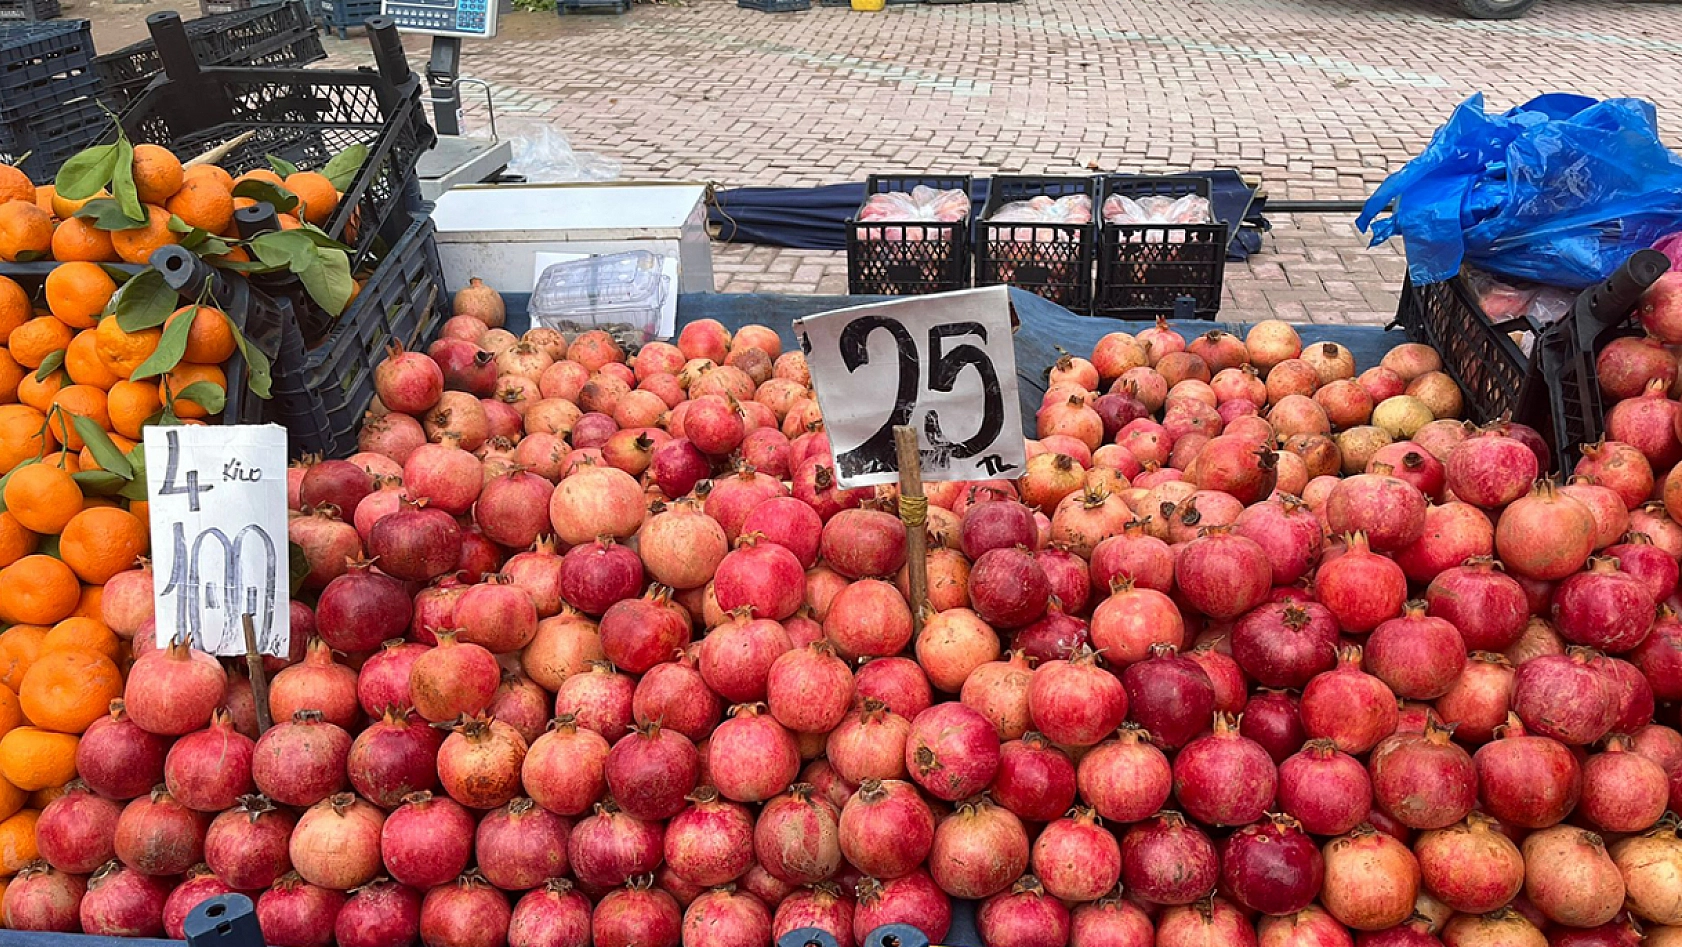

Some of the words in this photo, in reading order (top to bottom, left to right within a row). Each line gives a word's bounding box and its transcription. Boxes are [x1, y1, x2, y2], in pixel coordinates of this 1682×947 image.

[836, 315, 1005, 479] 25
[975, 454, 1018, 476] TL
[158, 430, 214, 512] 4
[160, 521, 276, 653] 100
